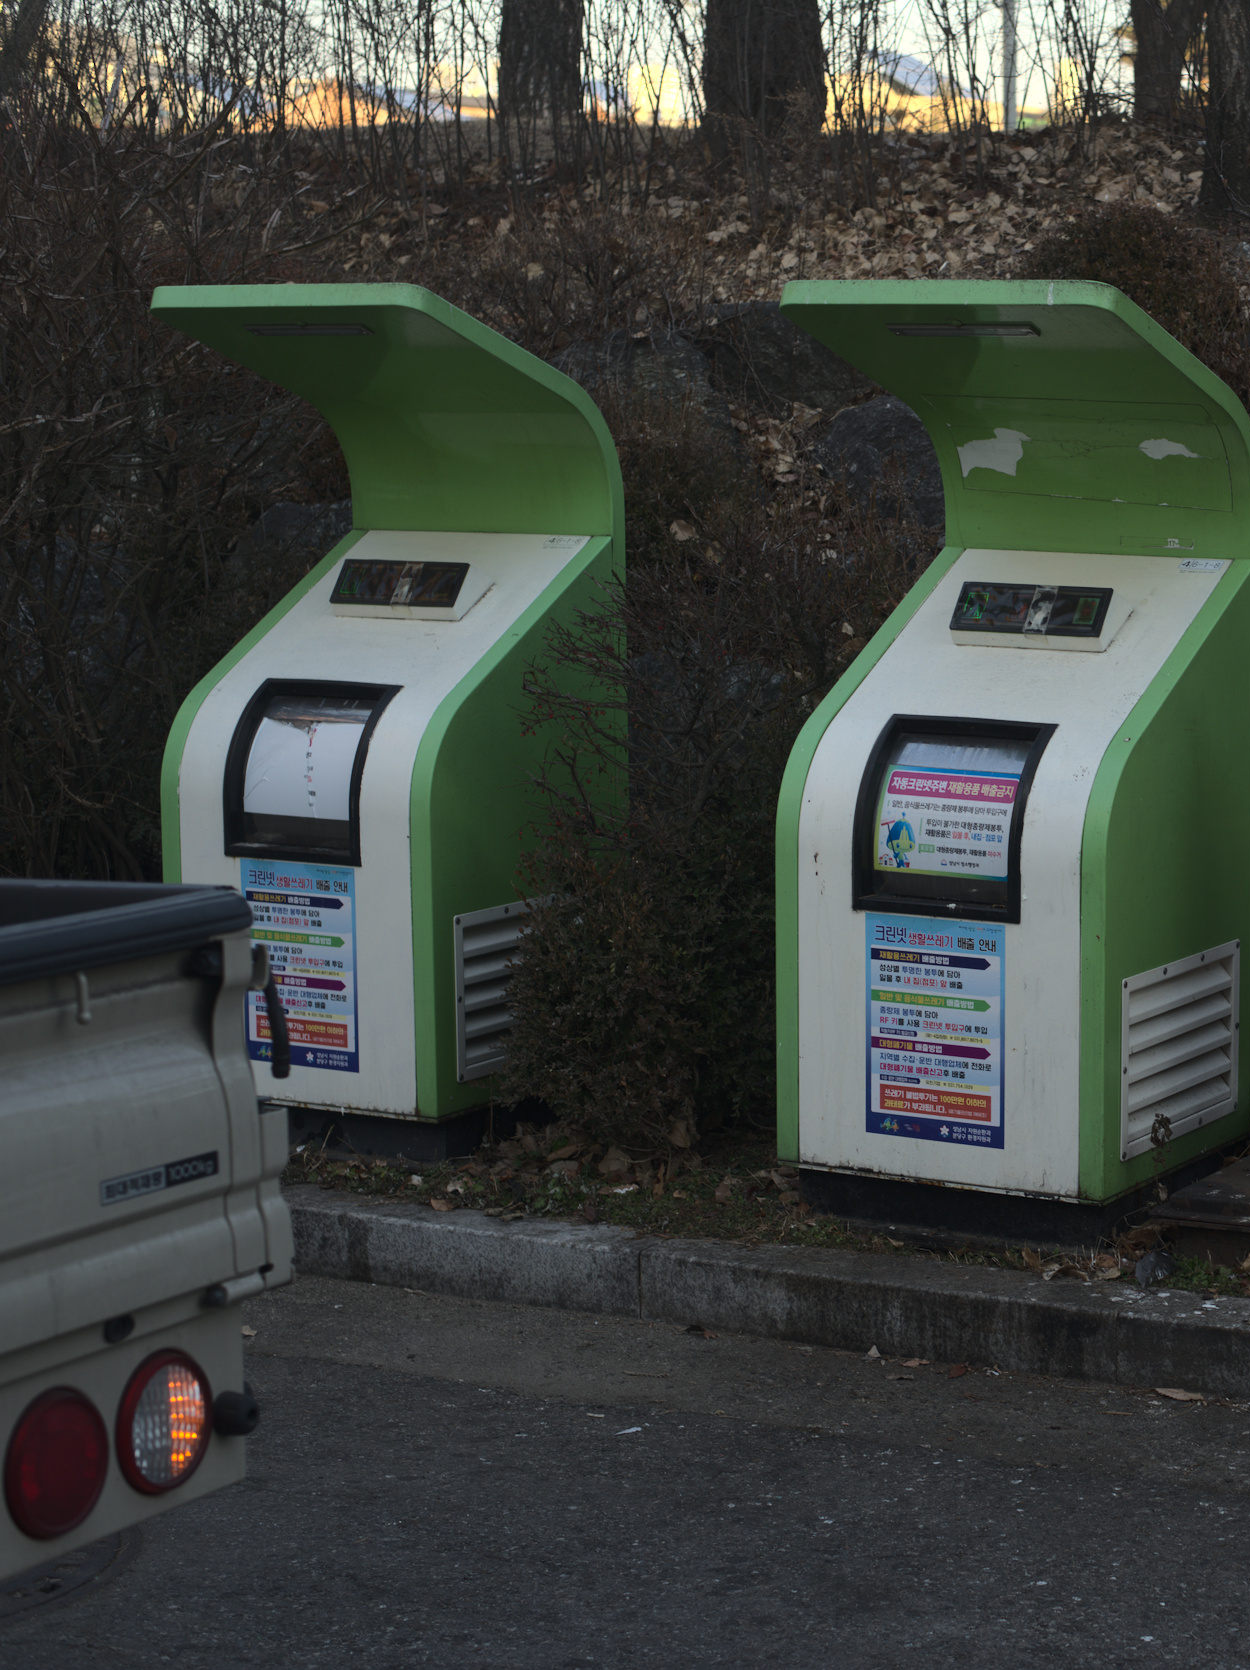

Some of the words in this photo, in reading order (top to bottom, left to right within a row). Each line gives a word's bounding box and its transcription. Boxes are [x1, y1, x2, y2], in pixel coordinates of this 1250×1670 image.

[892, 777, 948, 793] 자동크린넷주변
[948, 782, 980, 794] 재활용품
[981, 785, 1014, 798] 배출금지
[926, 819, 942, 828] 투입이
[249, 870, 275, 886] 크린넷
[276, 877, 313, 890] 생활쓰레기
[316, 880, 330, 891] 배출
[333, 881, 348, 893] 안내
[875, 926, 907, 944] 크린넷
[908, 932, 953, 949] 생활쓰레기
[958, 937, 975, 950] 배출
[979, 939, 996, 952] 안내
[879, 951, 920, 962] 재활용쓰레기
[880, 963, 900, 973] 성상별
[902, 966, 922, 975] 투명한
[925, 969, 945, 978] 봉투에
[947, 970, 960, 979] 담아
[904, 977, 911, 985] 내
[940, 980, 947, 988] 앞
[950, 981, 963, 989] 배출
[880, 992, 893, 1001] 일반
[895, 993, 903, 1002] 및
[904, 994, 945, 1006] 음식물쓰레기
[880, 1006, 900, 1015] 종량제
[903, 1008, 922, 1018] 봉투에
[925, 1010, 938, 1019] 담아
[880, 1016, 889, 1024] RF
[892, 1018, 904, 1026] 키를
[907, 1019, 920, 1028] 사용
[923, 1021, 942, 1030] 크린넷
[945, 1023, 972, 1033] 투입구에
[975, 1026, 987, 1035] 투입
[880, 1039, 913, 1050] 대형폐기물
[880, 1053, 900, 1062] 지역별
[935, 1059, 969, 1070] 대행업체에
[972, 1062, 992, 1072] 전화로
[880, 1063, 913, 1073] 대형폐기물
[916, 1066, 949, 1076] 배출신고후
[952, 1070, 965, 1079] 배출
[884, 1089, 904, 1098] 쓰레기
[906, 1090, 938, 1102] 불법투기는
[940, 1095, 965, 1105] 100만원
[966, 1098, 987, 1108] 이하의
[884, 1099, 911, 1110] 과태료가
[912, 1102, 946, 1114] 부과됩니다.
[170, 1161, 214, 1181] 1000kg
